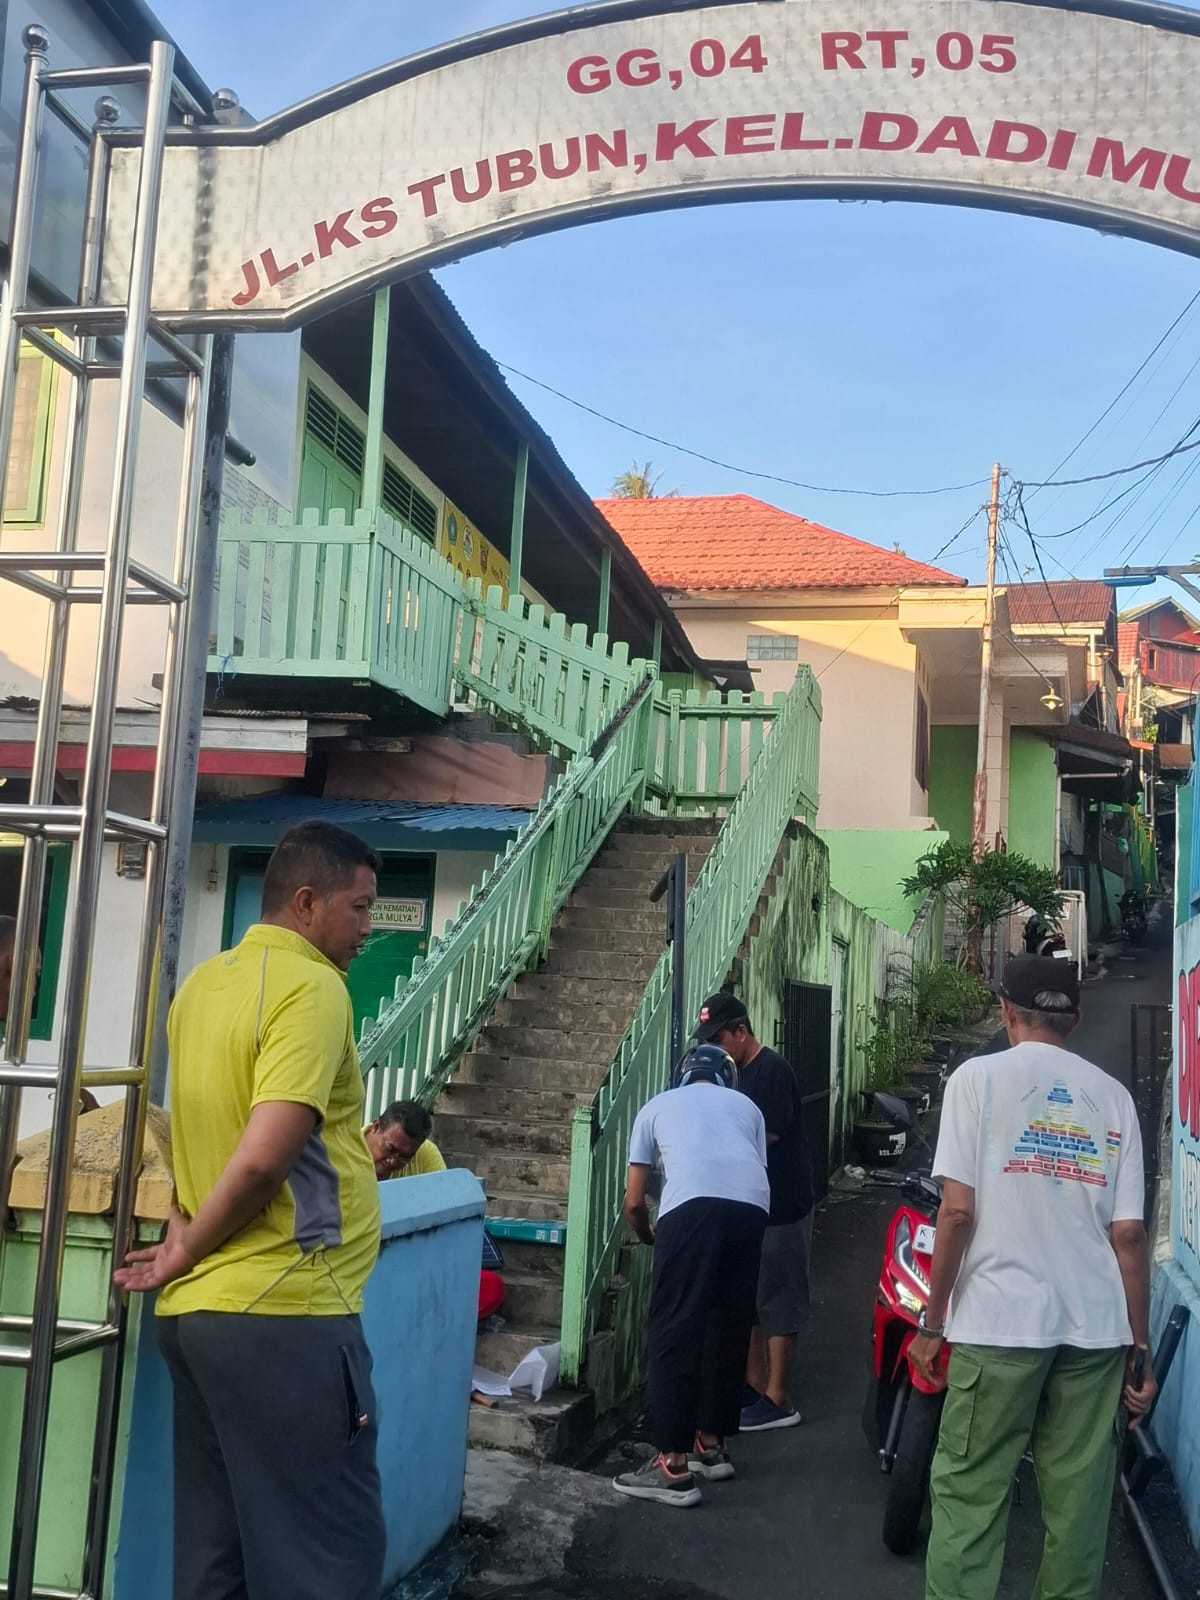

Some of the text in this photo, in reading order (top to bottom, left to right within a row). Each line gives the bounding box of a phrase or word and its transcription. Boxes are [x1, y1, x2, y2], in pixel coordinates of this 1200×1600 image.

[567, 30, 1018, 95] GG,04 RT,05
[384, 904, 417, 913] KEMATIAN
[386, 912, 412, 923] MULYA
